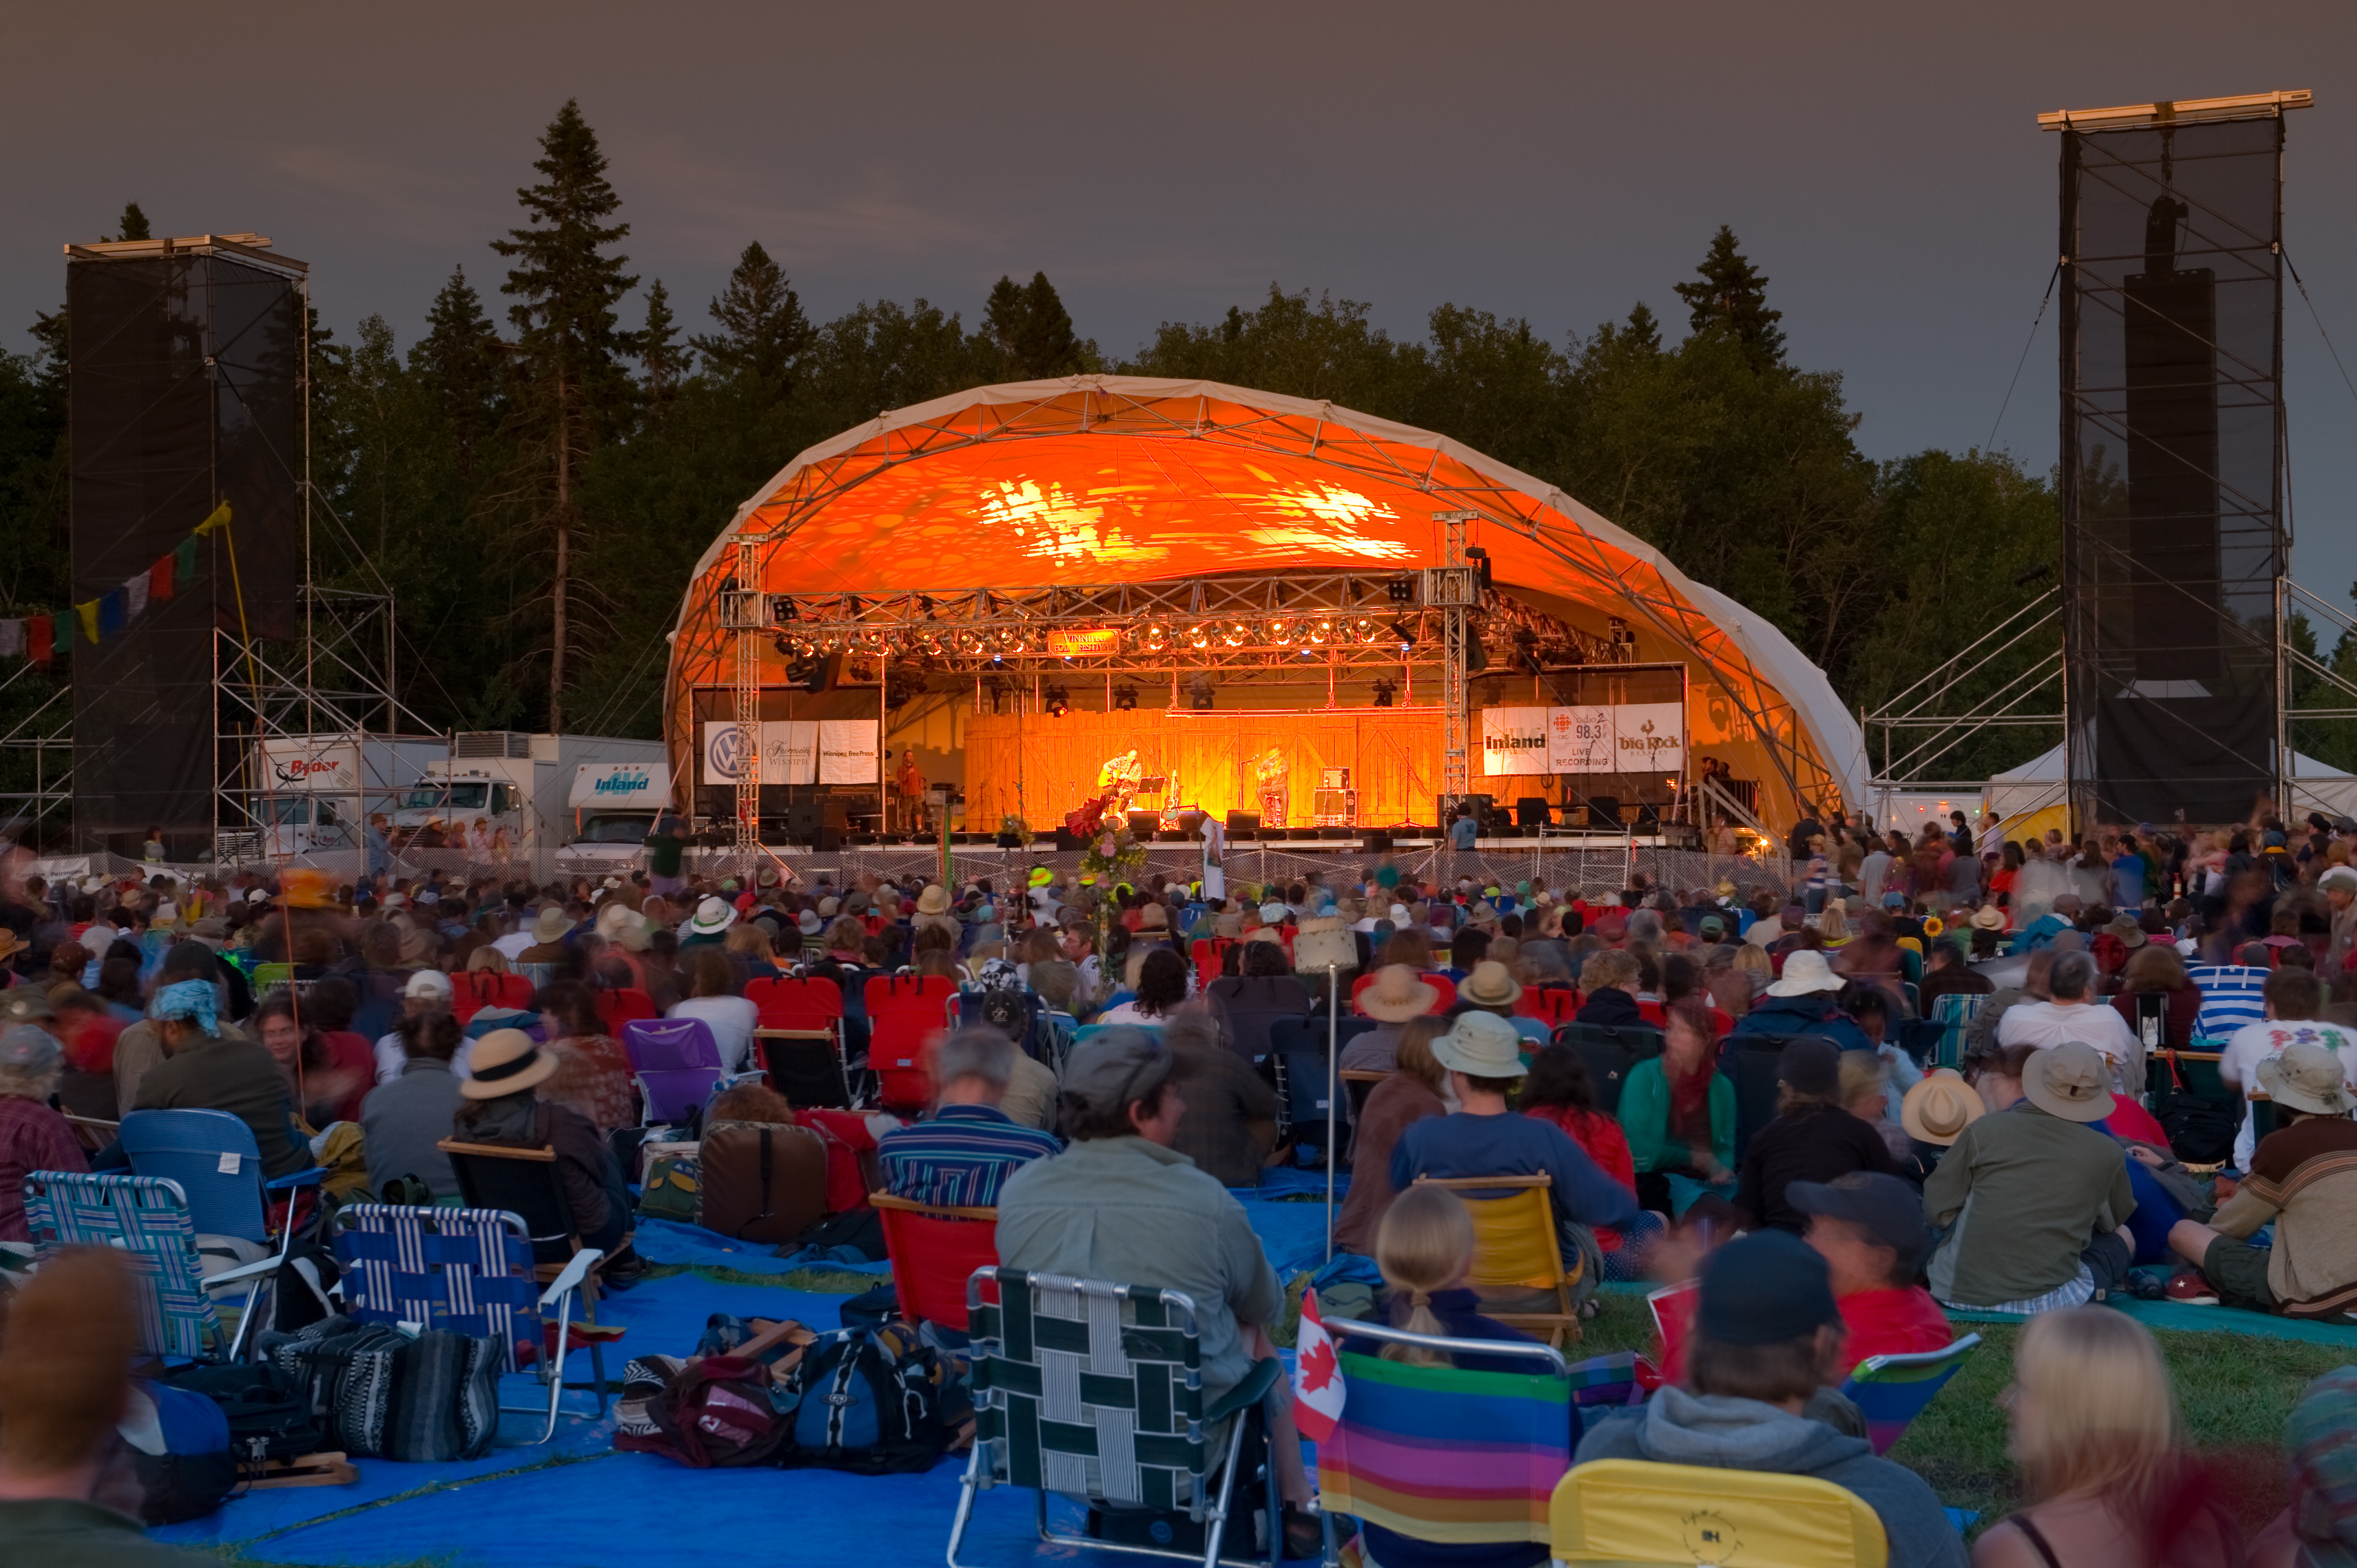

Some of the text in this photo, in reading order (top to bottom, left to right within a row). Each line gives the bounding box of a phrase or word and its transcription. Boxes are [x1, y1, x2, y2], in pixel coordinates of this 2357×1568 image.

[1576, 713, 1606, 724] radio 2
[1576, 725, 1601, 739] 98.3
[1486, 734, 1546, 749] Inland
[291, 760, 339, 776] Ryder
[594, 777, 650, 790] Inland
